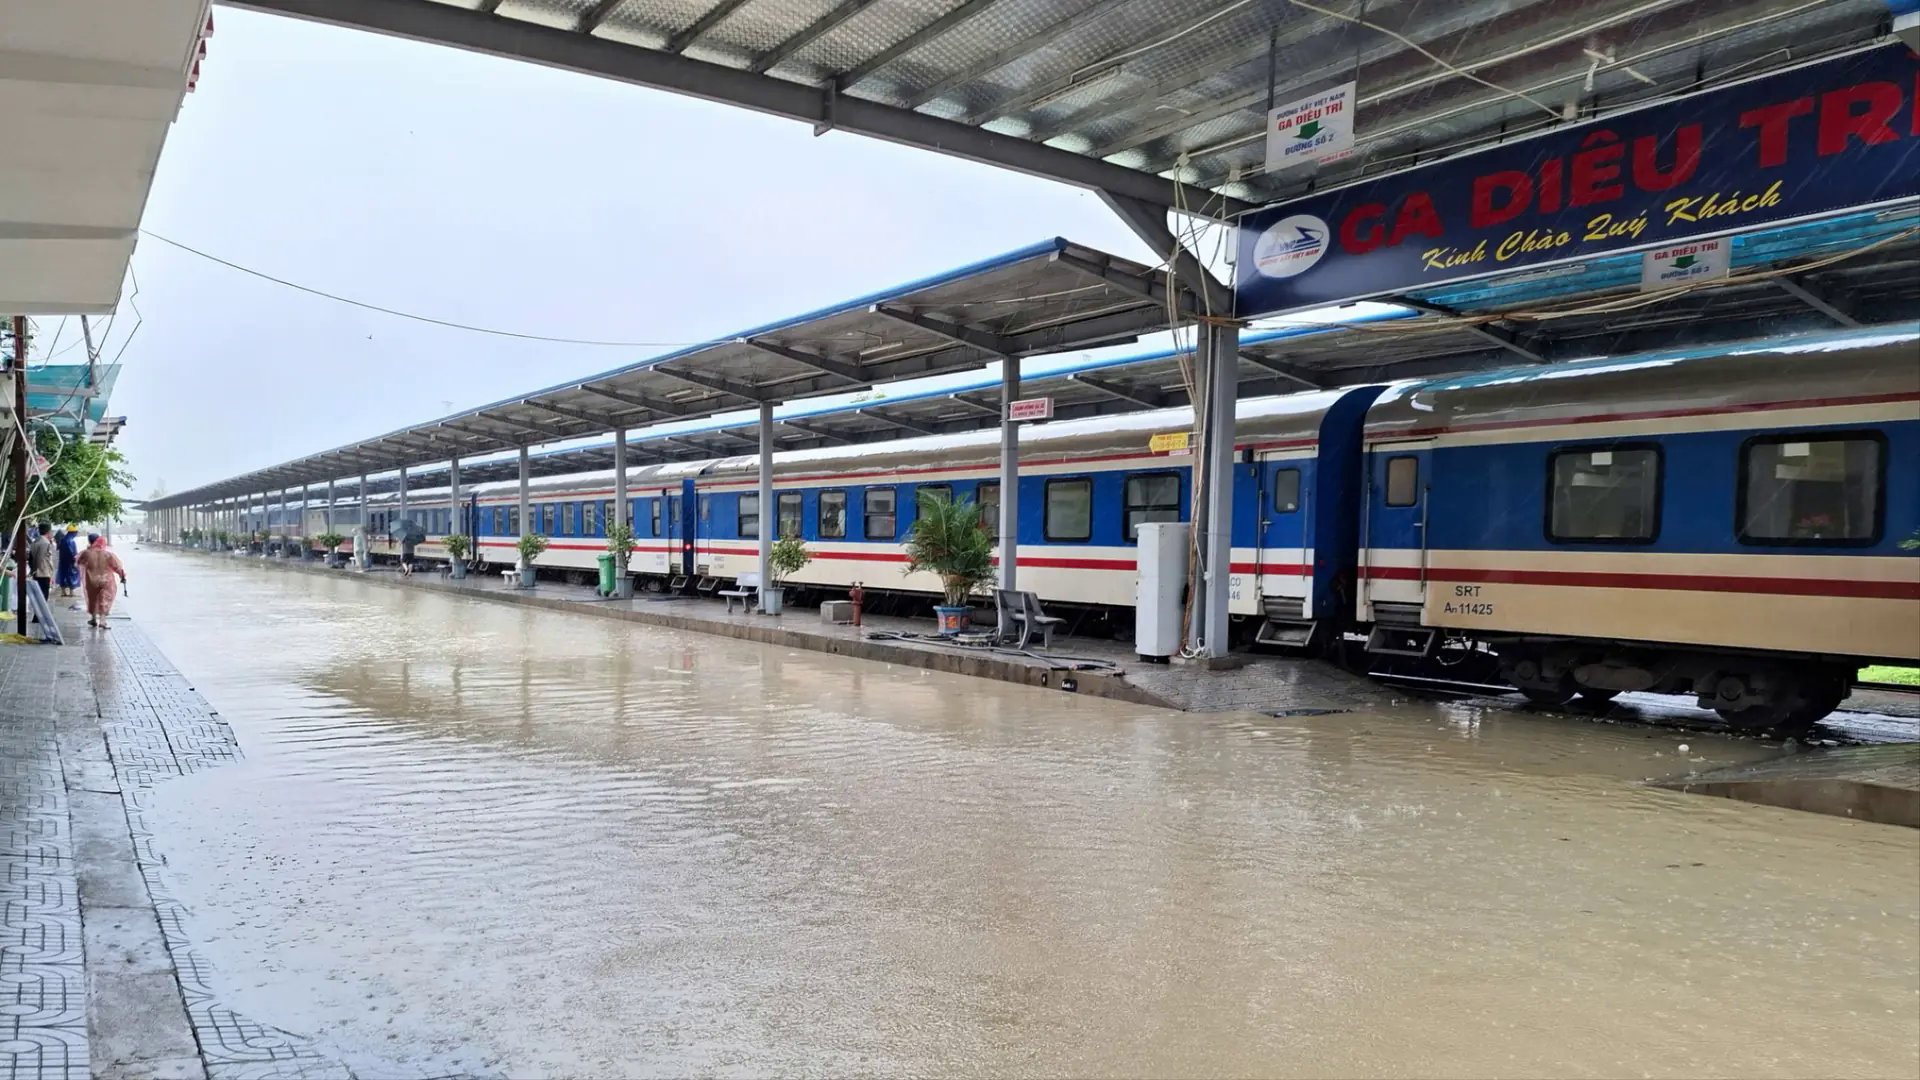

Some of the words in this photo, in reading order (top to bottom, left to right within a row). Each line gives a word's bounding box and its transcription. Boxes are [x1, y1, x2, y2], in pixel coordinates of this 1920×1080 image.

[1329, 91, 1346, 103] NAM
[1278, 118, 1293, 131] GA
[1295, 107, 1322, 126] DIÊU
[1325, 100, 1344, 117] TRÌ
[1328, 132, 1335, 143] 2
[1339, 191, 1444, 255] GA
[1471, 129, 1704, 229] DIÊU
[1495, 227, 1573, 262] Chào
[1582, 209, 1648, 241] Quý
[1664, 179, 1784, 227] Khách
[1654, 251, 1669, 261] GA
[1455, 585, 1482, 597] SRT
